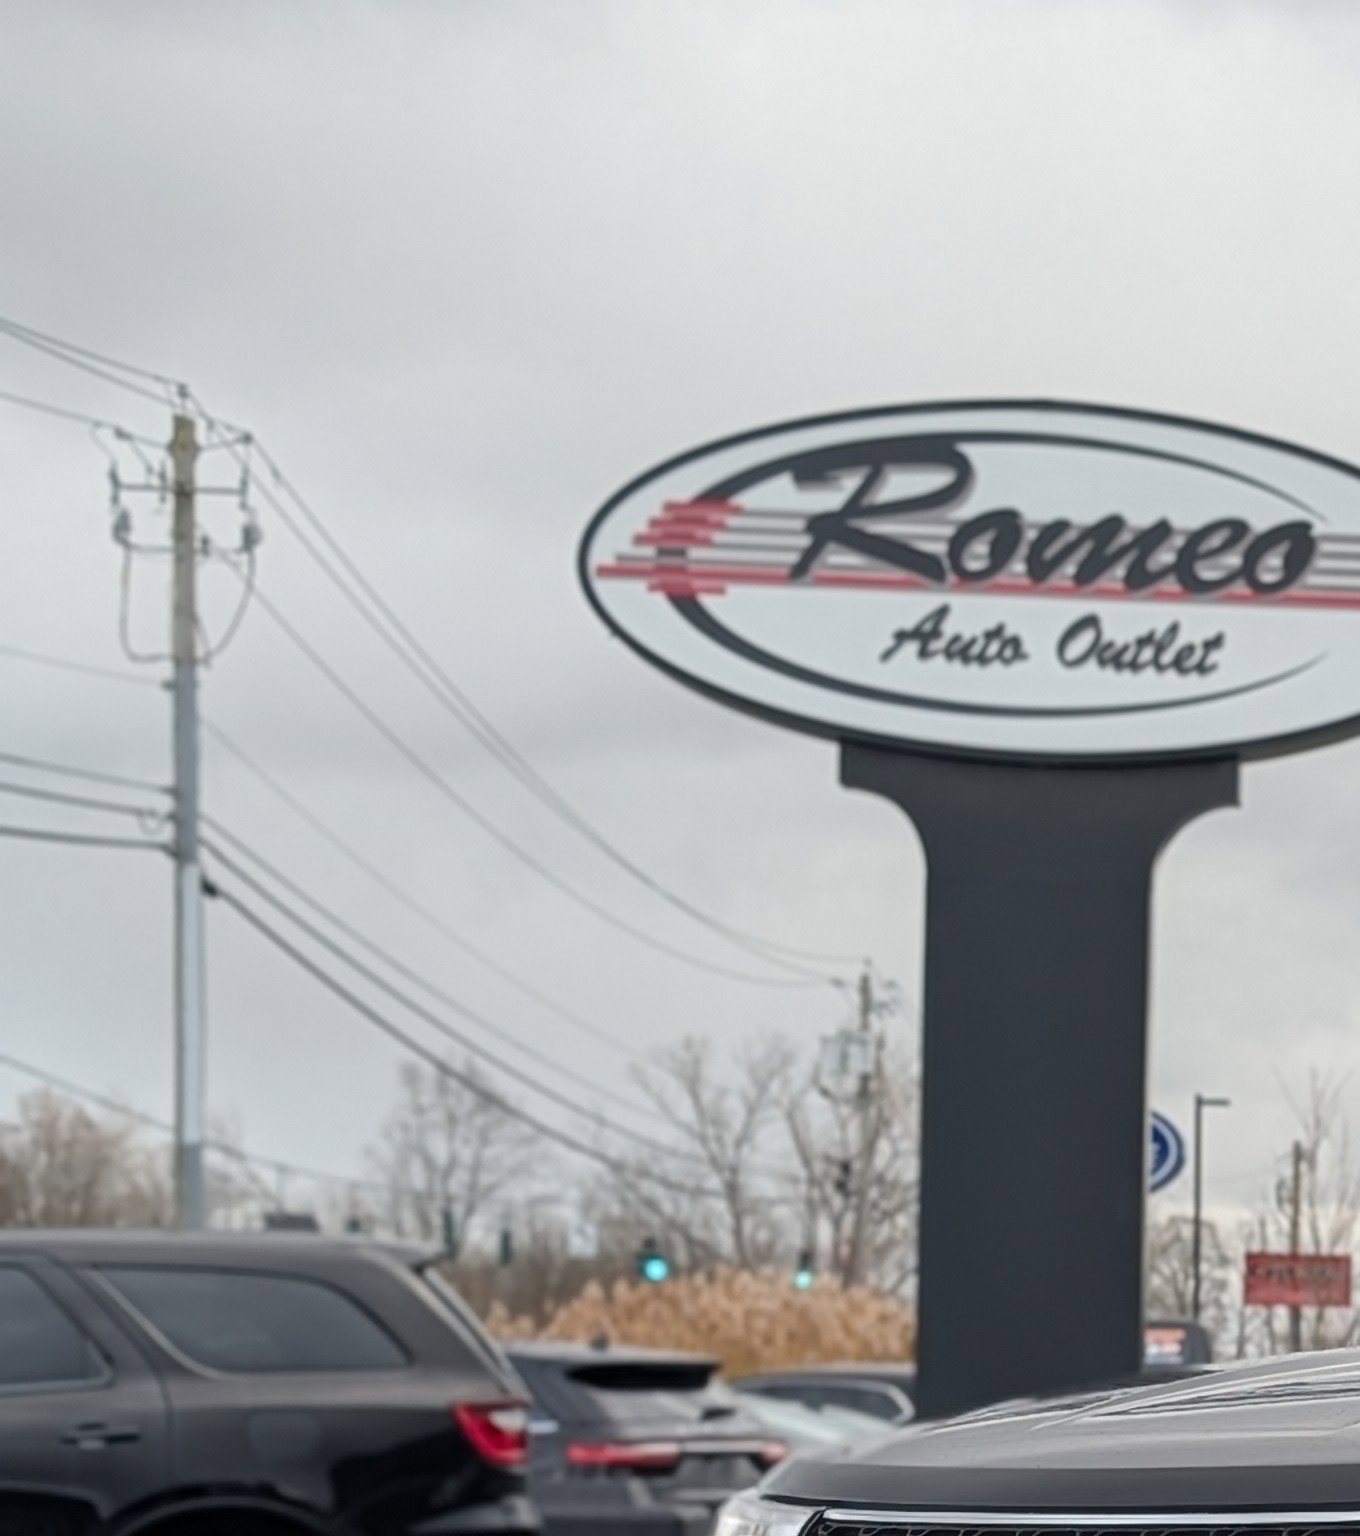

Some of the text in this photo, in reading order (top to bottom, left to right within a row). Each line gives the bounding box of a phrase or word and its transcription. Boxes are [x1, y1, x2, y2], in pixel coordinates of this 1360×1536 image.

[791, 440, 1320, 597] Romeo
[880, 603, 1227, 679] Auto Outlet
